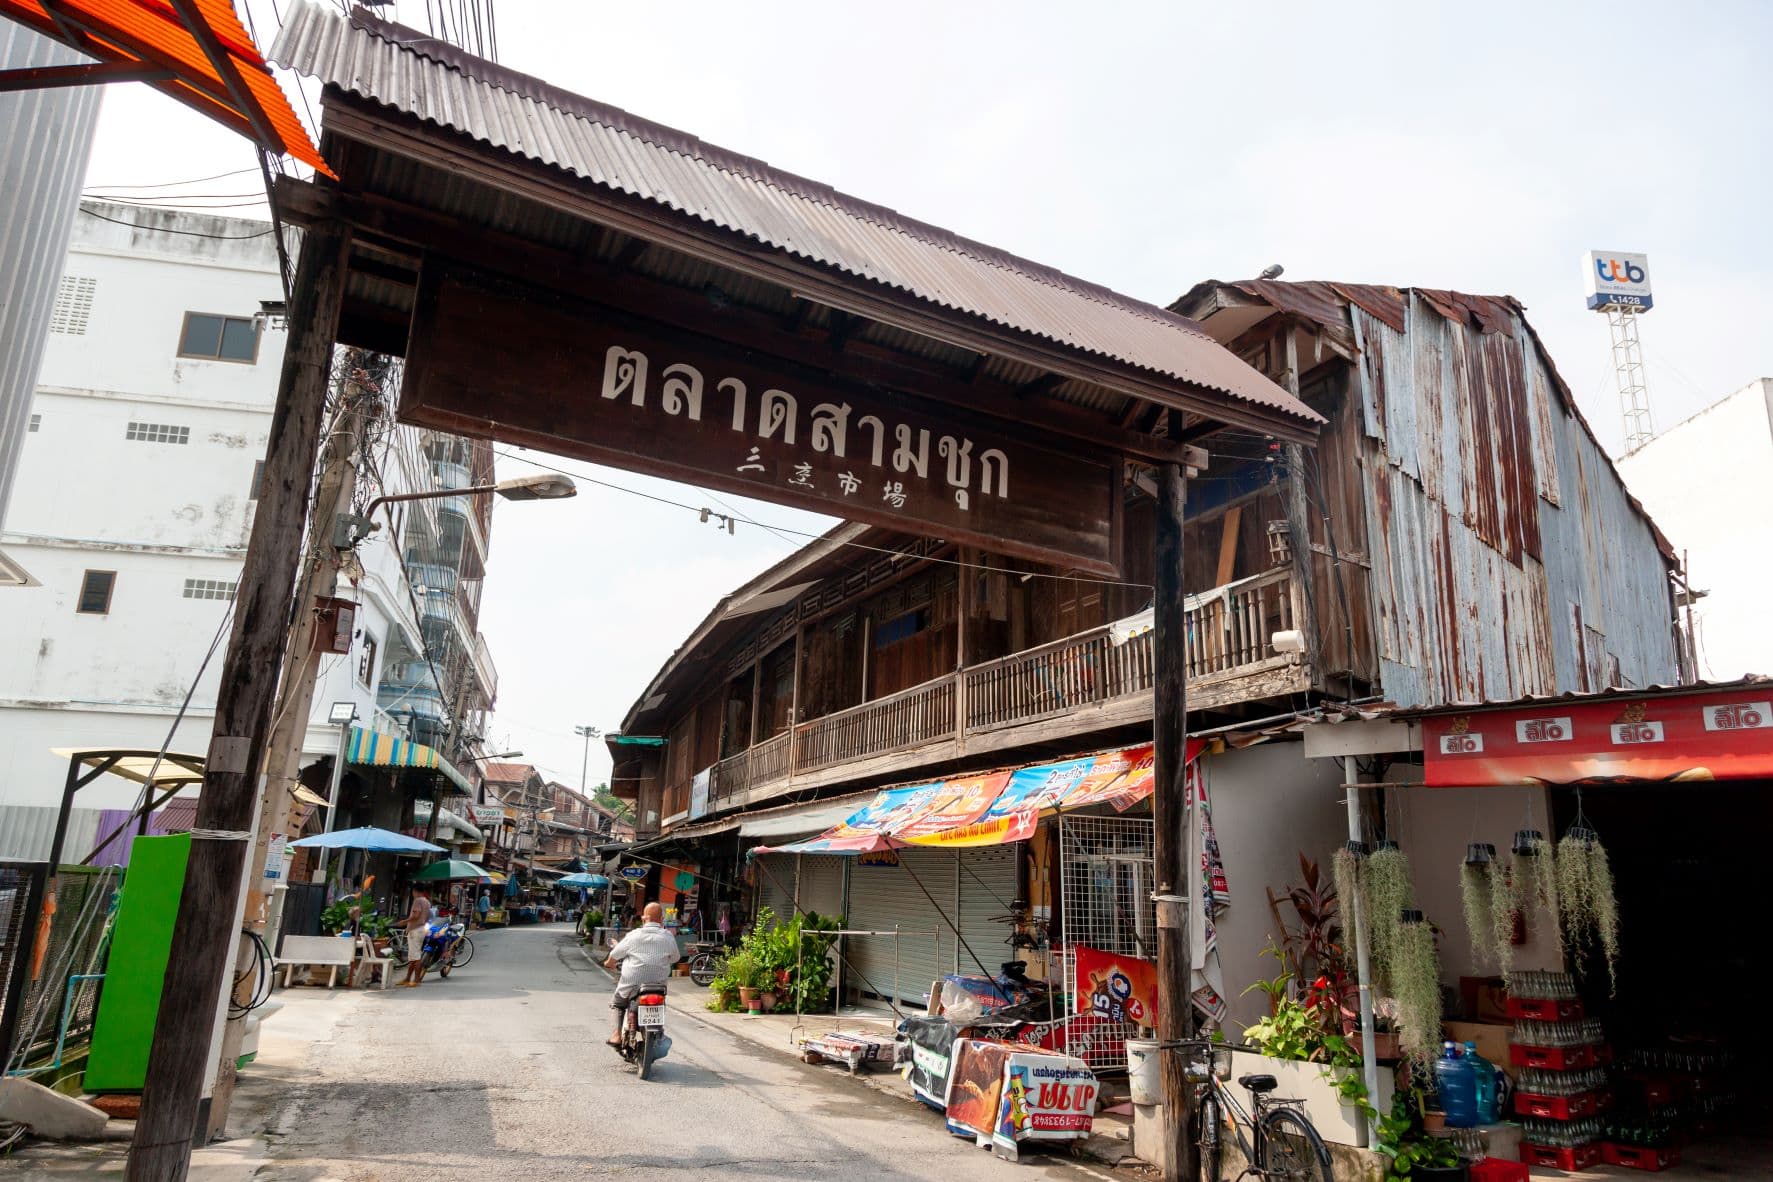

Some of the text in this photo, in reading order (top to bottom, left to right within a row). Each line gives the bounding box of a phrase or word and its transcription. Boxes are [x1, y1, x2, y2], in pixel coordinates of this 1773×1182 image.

[1596, 258, 1645, 284] ttb
[1617, 296, 1641, 305] 1428
[602, 345, 1008, 510] ตลาดสามชุก
[1714, 703, 1762, 729] ลีโอ
[1525, 718, 1564, 742] ลีโอ
[1619, 723, 1656, 744] ลีโอ
[1446, 735, 1477, 753] ลีโอ
